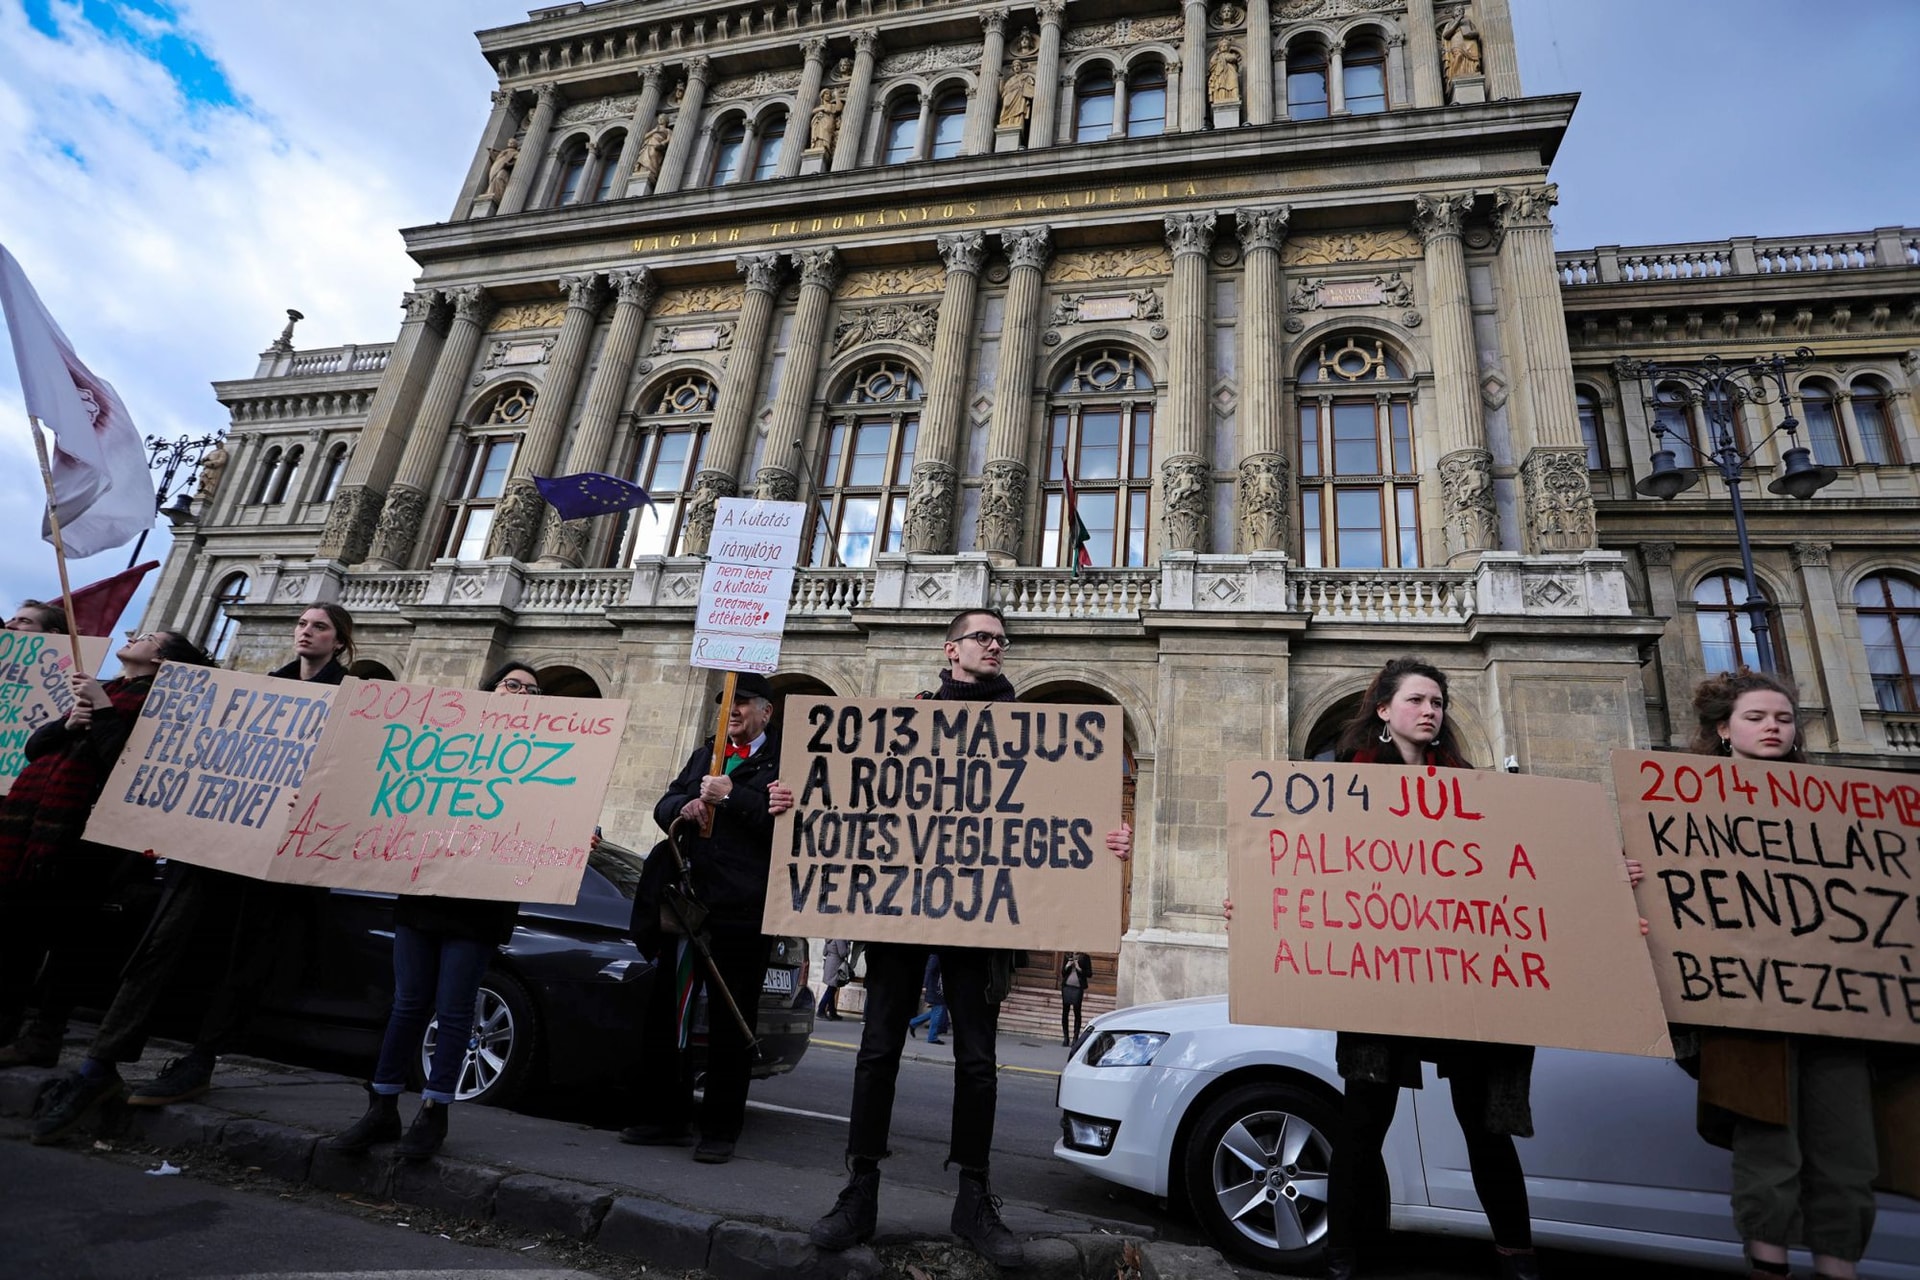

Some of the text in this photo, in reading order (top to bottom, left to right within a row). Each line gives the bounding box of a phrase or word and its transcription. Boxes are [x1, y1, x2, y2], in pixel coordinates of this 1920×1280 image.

[633, 182, 1195, 252] MAGYAR TUDOMÁNYOS AKADÉMIA
[722, 509, 733, 526] A
[713, 580, 768, 594] a kutatási
[717, 566, 773, 580] nem lehet
[714, 597, 765, 613] eredmény
[154, 664, 211, 694] 2012
[350, 683, 615, 736] 2013 március
[807, 702, 1106, 762] 2013 MÁJUS
[376, 723, 577, 786] RÖGHÖZ
[186, 774, 281, 829] TERVEI
[370, 766, 513, 820] KÖTÉS
[800, 752, 1028, 813] A RÖGHÖZ
[1250, 765, 1486, 820] 2014 JÚL
[1640, 760, 1759, 805] 2014
[790, 805, 1094, 869] KÖTÉS VÉGLEGES
[1269, 829, 1537, 881] PALKOVICS A
[1648, 811, 1920, 879] KANCELLÁR
[1273, 882, 1548, 942] FELSŐOKTATÁSI
[1657, 869, 1920, 949] RENDSZ
[1274, 938, 1550, 990] ALLAMTITKÁR
